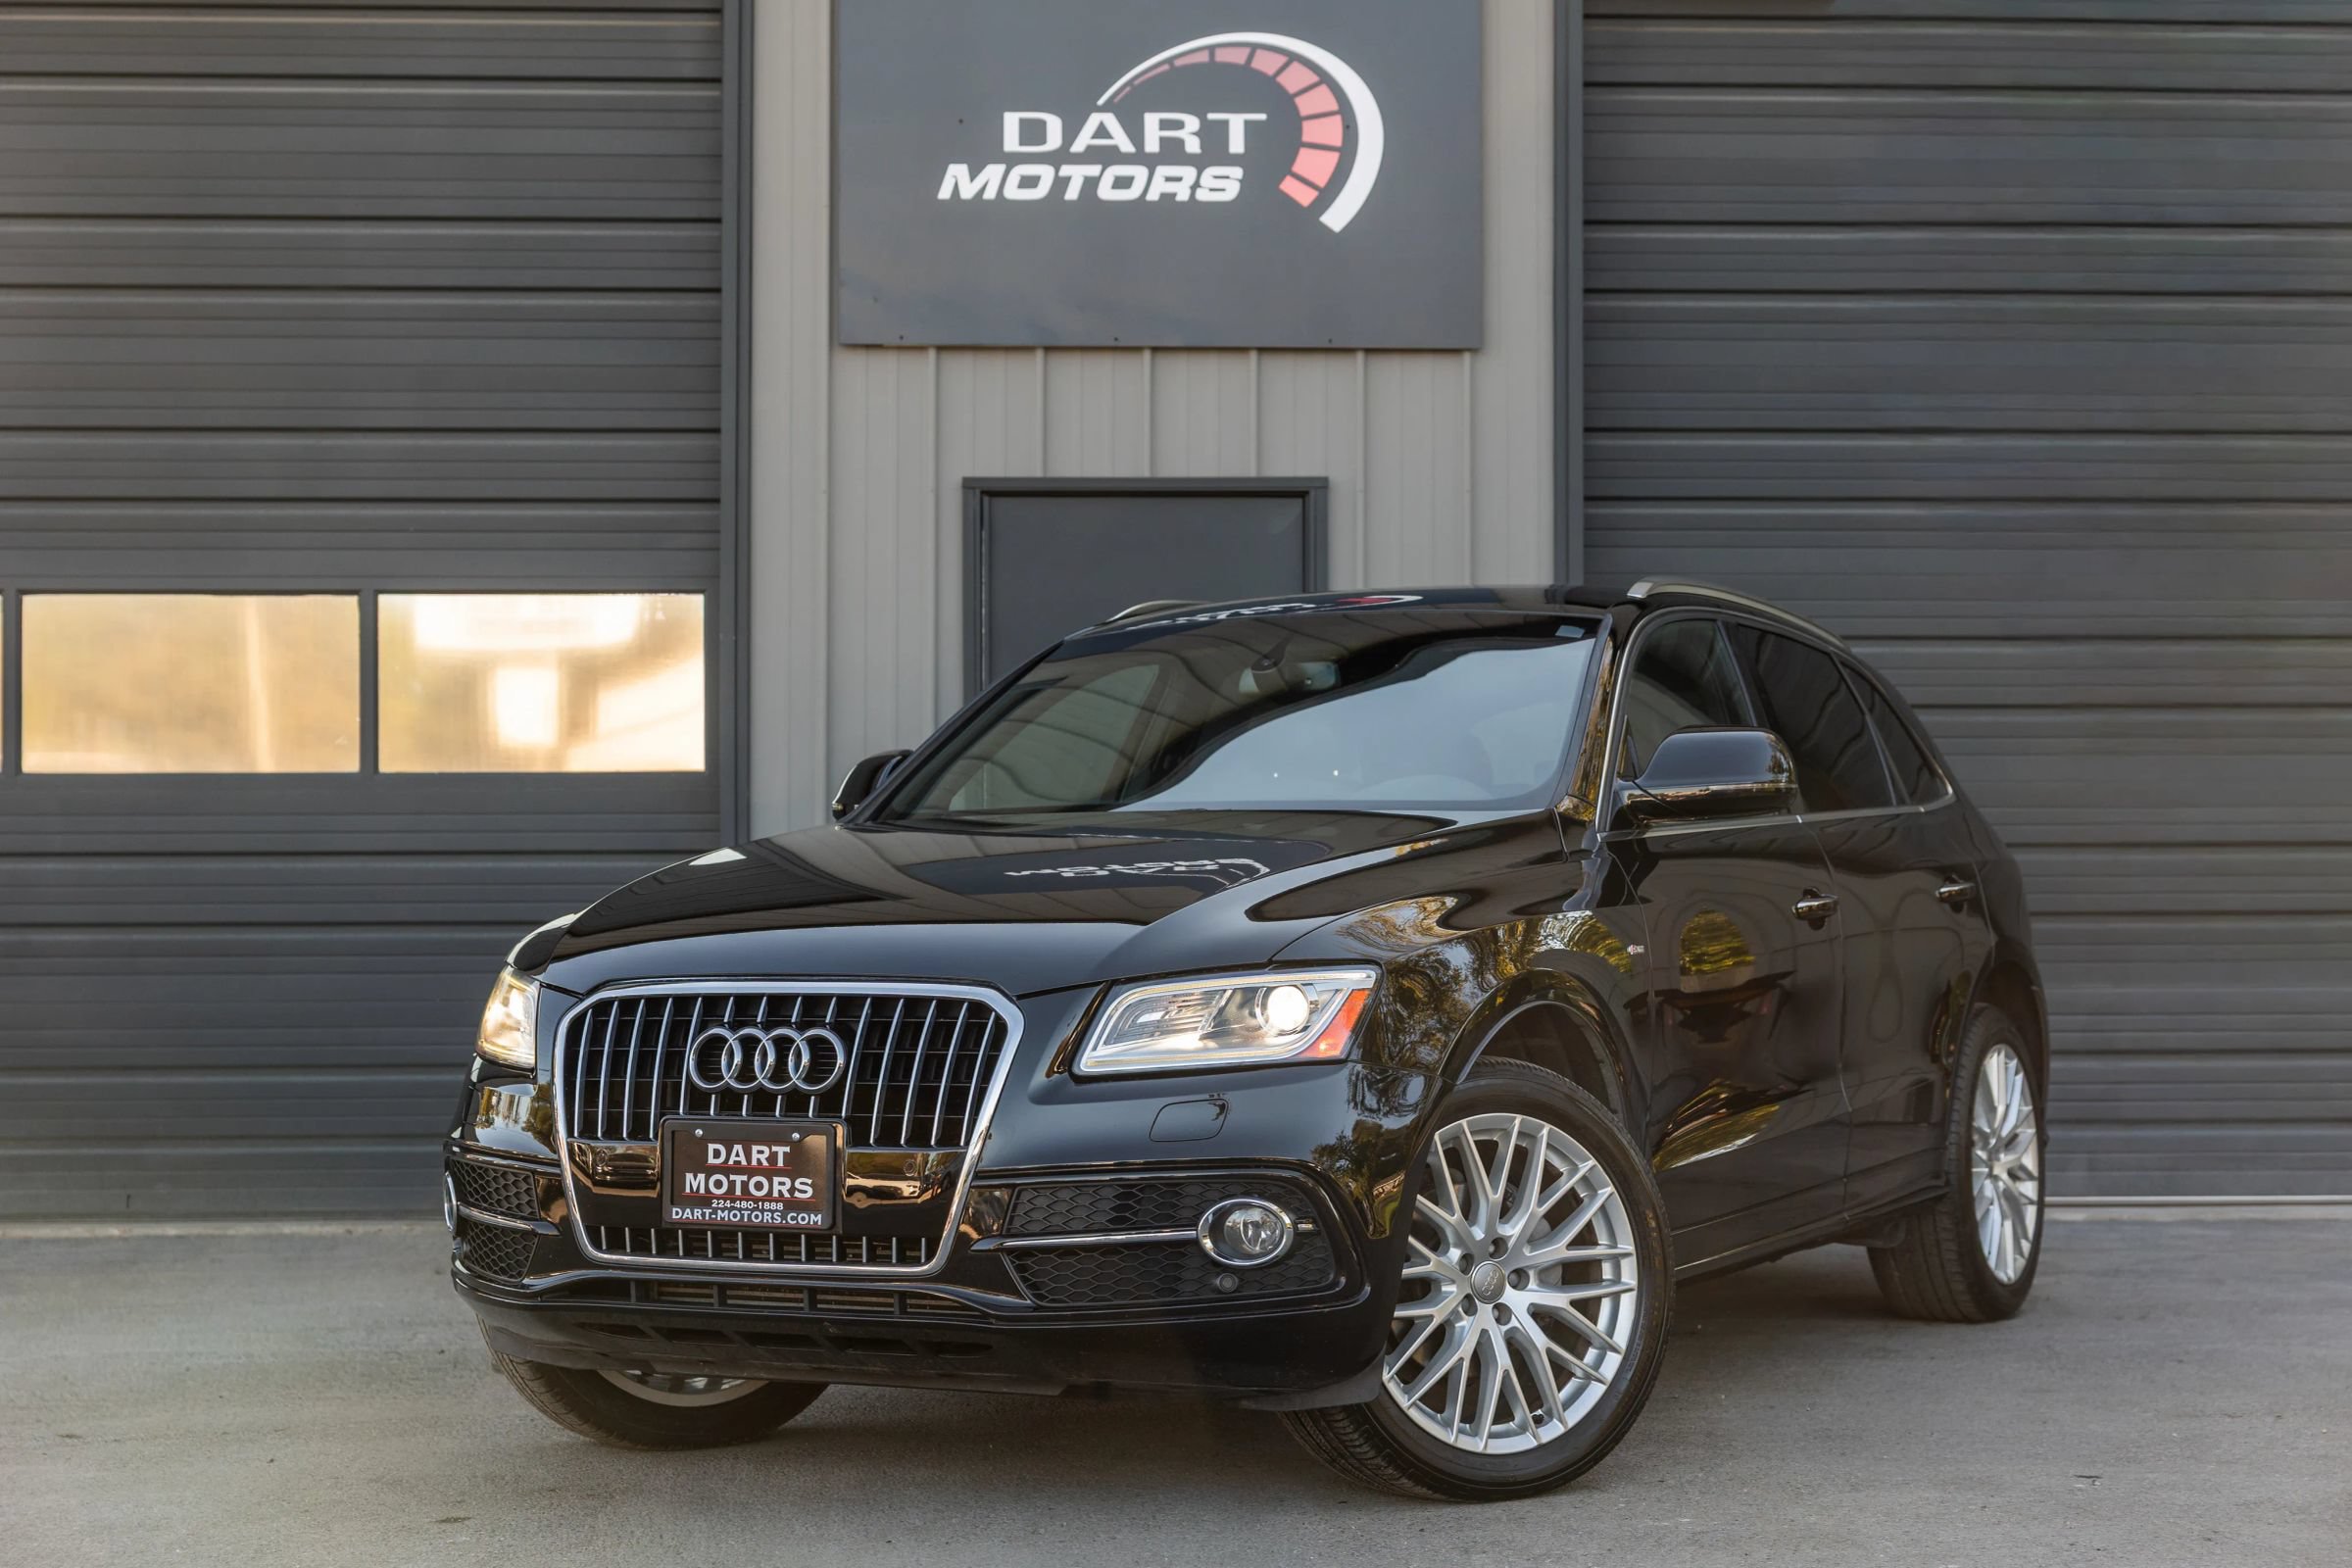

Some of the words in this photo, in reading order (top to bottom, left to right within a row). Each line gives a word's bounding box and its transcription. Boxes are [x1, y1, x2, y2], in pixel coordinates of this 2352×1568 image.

[1003, 111, 1268, 154] DART
[937, 163, 1245, 203] MOTORS
[707, 1143, 791, 1167] DART
[684, 1172, 814, 1199] MOTORS
[671, 1207, 822, 1225] DART-MOTORS.COM
[710, 1199, 784, 1210] 224-480-1888
